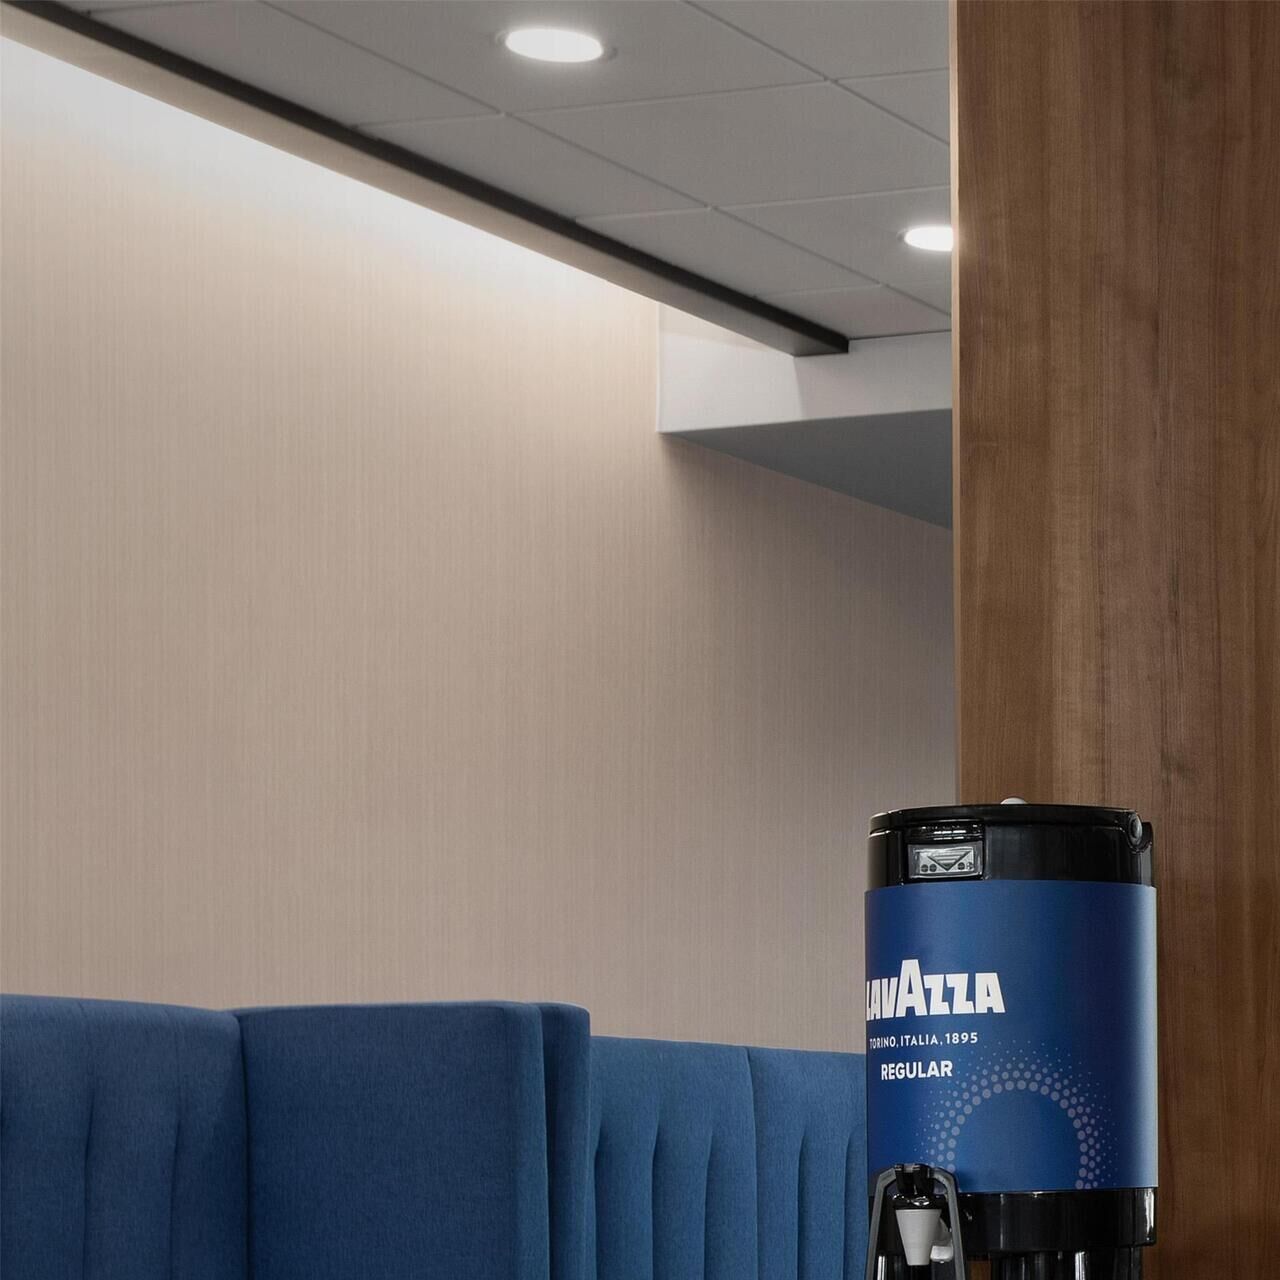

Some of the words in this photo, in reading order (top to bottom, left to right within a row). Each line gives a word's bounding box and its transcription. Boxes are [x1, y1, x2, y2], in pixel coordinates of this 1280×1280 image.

[866, 958, 1006, 1022] LAVAZZA
[945, 1032, 978, 1044] 1895
[881, 1060, 953, 1080] REGULAR
